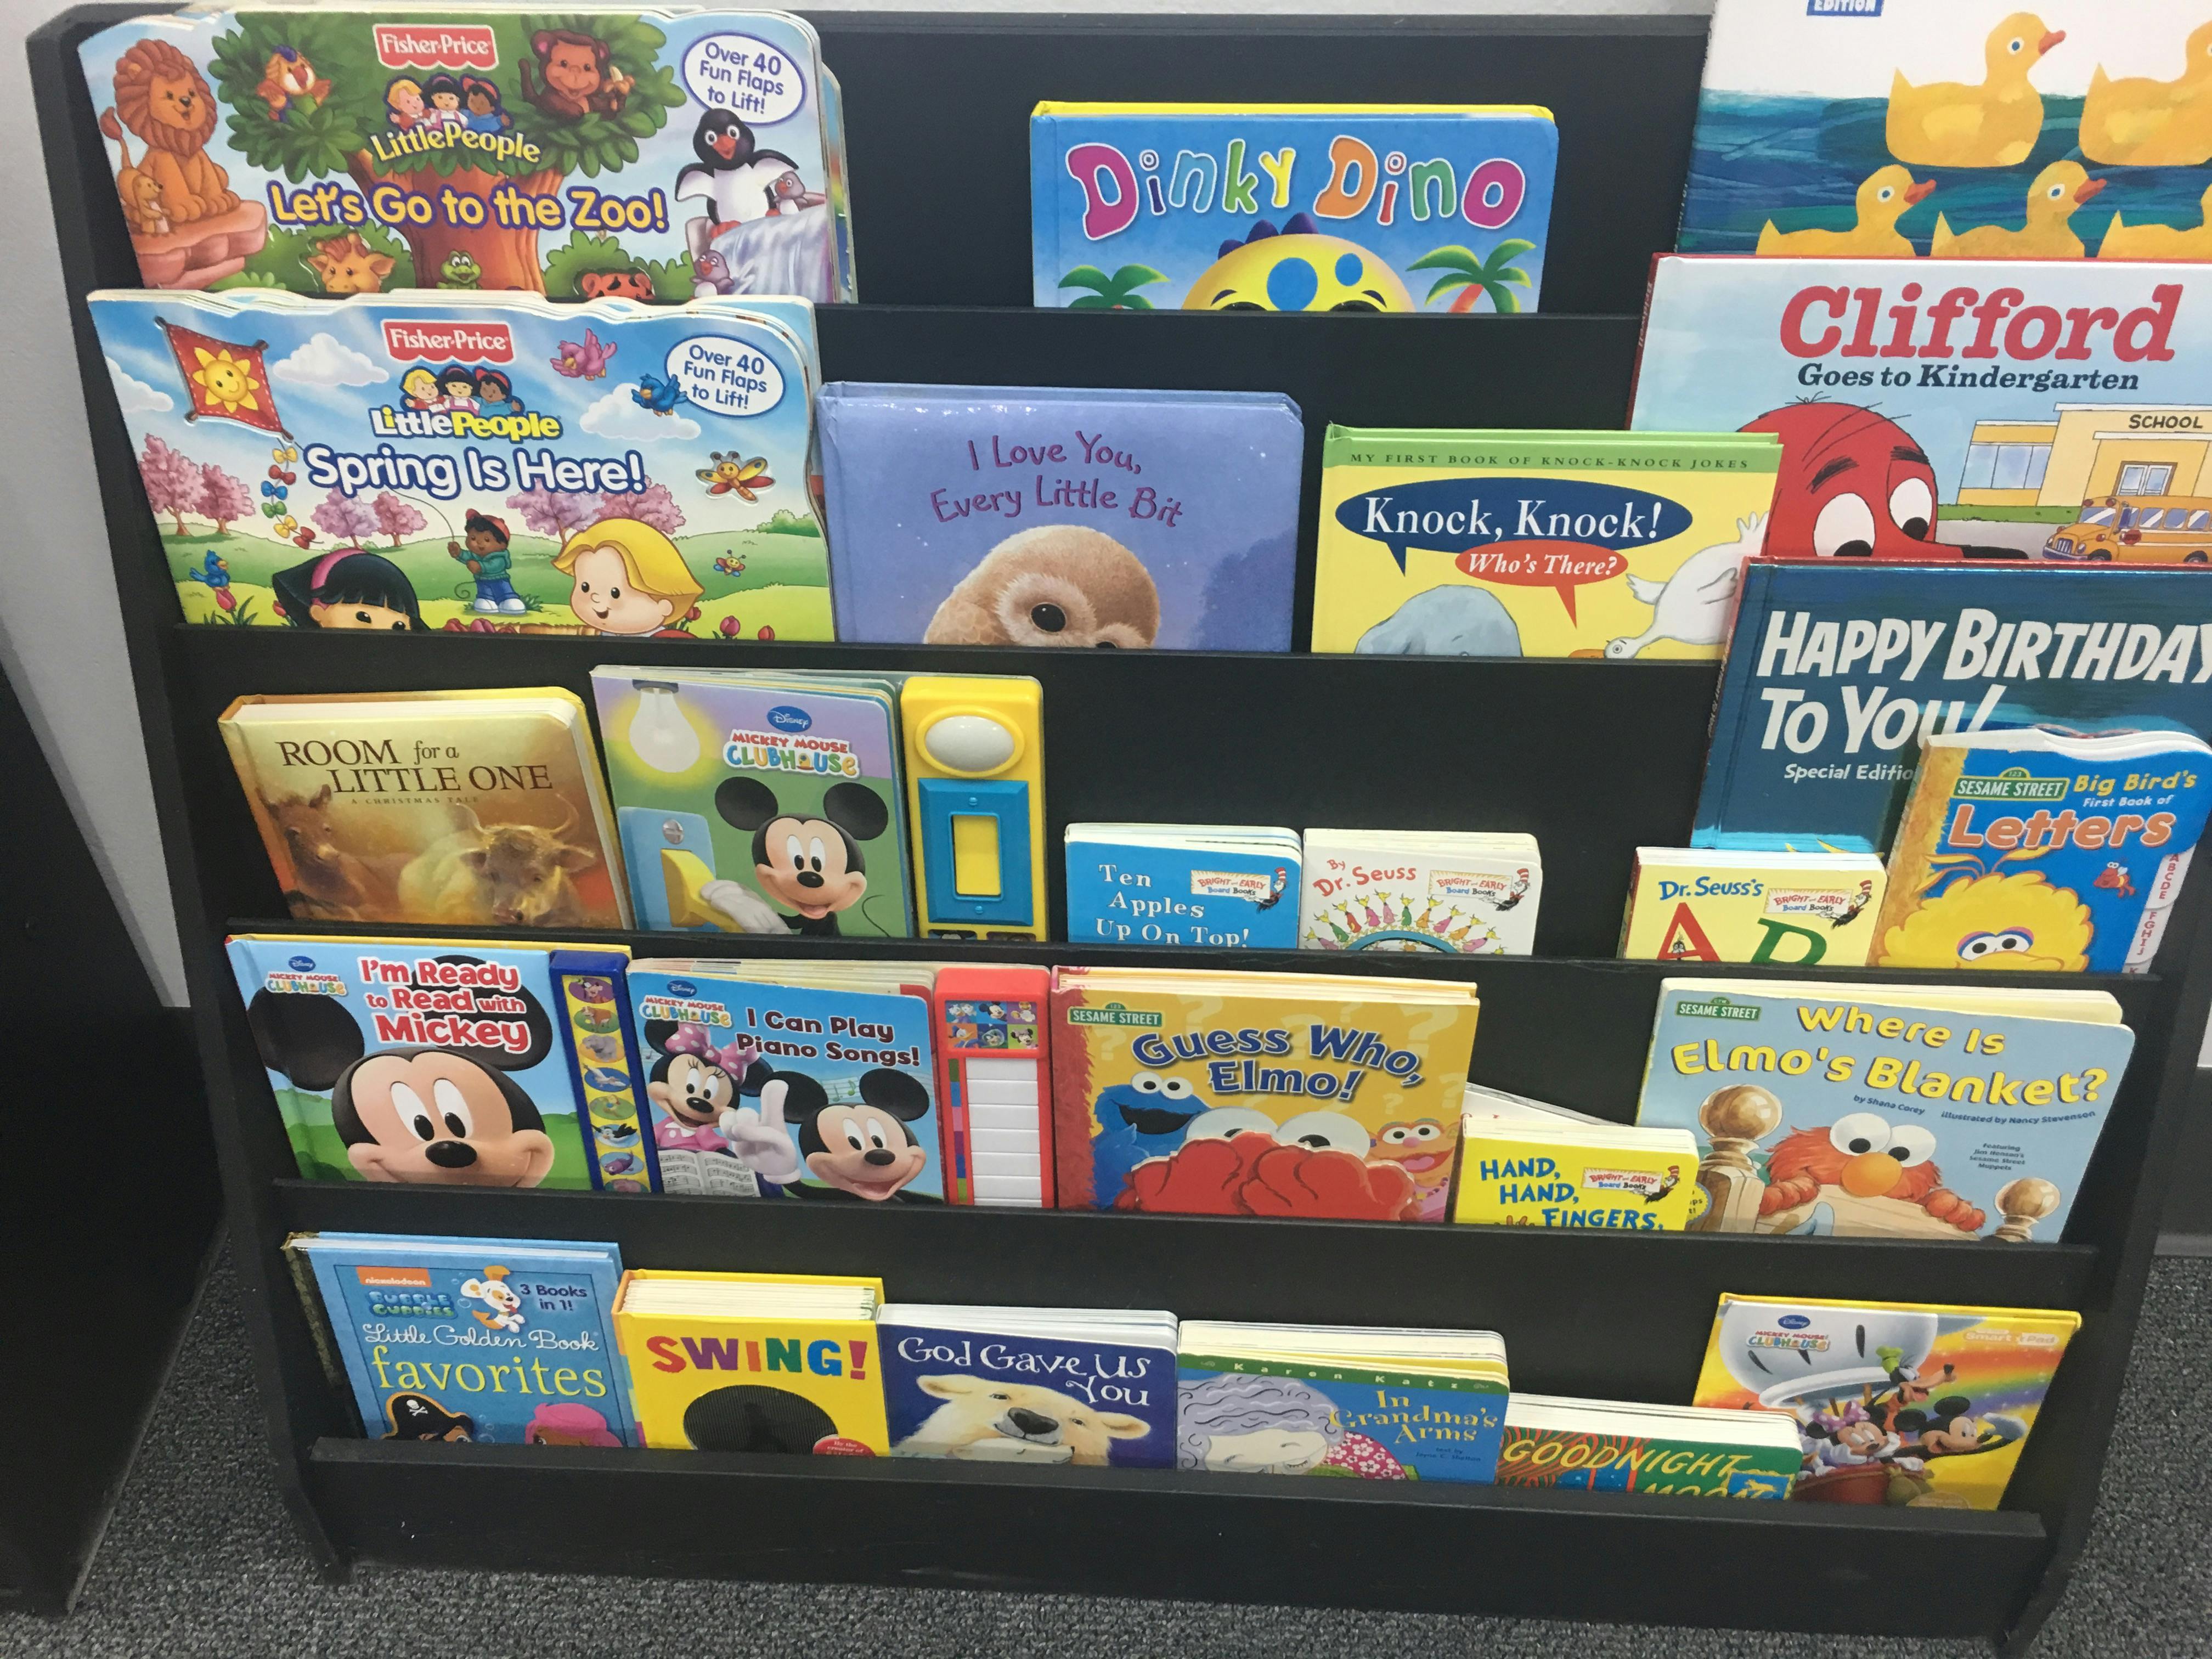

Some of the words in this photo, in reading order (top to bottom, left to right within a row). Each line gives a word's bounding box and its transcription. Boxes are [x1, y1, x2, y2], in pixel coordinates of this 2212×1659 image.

[381, 33, 490, 54] Fisher-Price
[705, 42, 748, 67] Over
[753, 55, 782, 77] 40
[699, 61, 732, 83] Fun
[737, 71, 784, 97] Flaps
[708, 86, 725, 104] to
[732, 93, 765, 115] Lift!
[1065, 138, 1296, 240] Dinky
[1313, 135, 1526, 229] Dino
[270, 183, 364, 225] Let's
[373, 187, 431, 223] Go
[442, 190, 484, 224] to
[488, 189, 561, 226] the
[573, 189, 668, 232] Zoo!
[1779, 282, 2183, 363] Clifford
[388, 329, 507, 352] Fisher-Price
[688, 343, 734, 370] Over
[737, 353, 766, 375] 40
[684, 363, 718, 384] Fun
[720, 369, 768, 395] Flaps
[1797, 363, 1875, 387] Goes
[1880, 366, 1911, 387] to
[1917, 364, 2139, 392] Kindergarten
[691, 384, 710, 402] to
[714, 390, 751, 411] Lift!
[2129, 414, 2204, 430] SCHOOL
[968, 440, 980, 471] I
[992, 435, 1067, 468] Love
[1075, 431, 1142, 474] You,
[1351, 454, 1375, 463] MY
[1385, 454, 1438, 464] FIRST
[1448, 455, 1499, 465] BOOK
[1509, 456, 1532, 465] OF
[1542, 457, 1682, 468] KNOCK-KNOCK
[1691, 459, 1748, 470] JOKES
[307, 447, 455, 498] Spring
[469, 452, 506, 489] Is
[521, 450, 646, 493] Here!
[930, 487, 1022, 523] Every
[1036, 475, 1118, 510] Little
[1128, 487, 1184, 527] Bit
[1363, 497, 1503, 540] Knock,
[1513, 500, 1662, 539] Knock!
[1468, 554, 1537, 574] Who's
[1544, 554, 1618, 577] There?
[1756, 611, 1948, 681] HAPPY
[1943, 608, 2212, 684] BIRTHDAY
[1760, 687, 1829, 754] TO
[275, 739, 403, 766] ROOM
[414, 741, 442, 765] for
[445, 745, 460, 759] a
[732, 732, 789, 747] MICKEY
[794, 739, 848, 754] MOUSE
[326, 767, 462, 793] LITTLE
[469, 765, 553, 791] ONE
[1784, 764, 1850, 783] Special
[2073, 775, 2115, 797] Big
[2123, 770, 2197, 791] Bird's
[1957, 780, 2012, 795] SESAME
[2013, 782, 2063, 797] STREET
[2083, 797, 2115, 808] First
[2119, 796, 2152, 806] Book
[2157, 793, 2176, 805] of
[1948, 804, 2177, 850] Letters
[1098, 864, 1152, 887] Ten
[1327, 859, 1346, 871] By
[1197, 877, 1232, 887] BRIGHT
[1239, 879, 1266, 889] EARLY
[1233, 887, 1256, 895] Books
[1312, 877, 1351, 896] Dr.
[1352, 865, 1417, 885] Seuss
[1436, 877, 1471, 888] BRIGHT
[1479, 880, 1508, 891] EARLY
[1472, 888, 1496, 897] Books
[1658, 880, 1691, 901] Dr.
[1694, 876, 1764, 896] Seuss's
[1107, 891, 1205, 918] Apples
[1773, 895, 1810, 906] BRIGHT
[1817, 895, 1847, 905] EARLY
[1096, 918, 1131, 941] Up
[1142, 924, 1181, 945] On
[1190, 927, 1250, 947] Top!
[1656, 902, 1722, 962] A
[361, 959, 414, 984] I'm
[417, 961, 520, 990] Ready
[366, 994, 387, 1009] to
[394, 988, 475, 1012] Read
[480, 998, 526, 1013] with
[646, 997, 684, 1007] MICKEY
[687, 1001, 724, 1012] MOUSE
[1679, 1003, 1719, 1016] SESAME
[1720, 1006, 1758, 1019] STREET
[746, 1008, 756, 1026] I
[765, 1011, 823, 1034] Can
[831, 1017, 895, 1043] Play
[1073, 1010, 1116, 1023] SESAME
[1119, 1013, 1159, 1025] STREET
[1797, 1006, 1950, 1049] Where
[1965, 1028, 2006, 1056] Is
[375, 1013, 530, 1053] Mickey
[736, 1032, 818, 1058] Piano
[826, 1042, 921, 1067] Songs!
[1131, 1029, 1289, 1066] Guess
[1310, 1024, 1426, 1087] Who,
[1207, 1059, 1364, 1102] Elmo!
[1672, 1039, 1857, 1083] Elmo's
[1864, 1056, 2109, 1107] Blanket?
[1853, 1094, 1866, 1103] by
[1867, 1097, 1896, 1109] Shana
[1897, 1103, 1926, 1115] Corey
[1941, 1110, 1993, 1123] illustrated
[1994, 1116, 2007, 1125] by
[2009, 1116, 2040, 1125] Nancy
[2041, 1110, 2096, 1124] Stevenson
[1480, 1157, 1561, 1181] HAND,
[1589, 1173, 1624, 1182] BRIGHT
[1630, 1175, 1658, 1184] EARLY
[1499, 1183, 1580, 1205] HAND,
[1542, 1207, 1664, 1230] FINGERS,
[365, 1277, 426, 1285] nickelodeon
[520, 1284, 531, 1295] 3
[537, 1284, 588, 1299] Books
[369, 1291, 450, 1306] BUBBLE
[539, 1299, 556, 1310] in
[560, 1299, 573, 1311] 1!
[363, 1323, 431, 1345] Little
[433, 1325, 527, 1348] Golden
[528, 1330, 600, 1352] Book
[1966, 1332, 2011, 1342] Smart
[646, 1335, 868, 1380] SWING!
[898, 1336, 972, 1367] God
[980, 1344, 1087, 1376] Gave
[371, 1345, 607, 1398] favorites
[1065, 1375, 1150, 1407] You
[1376, 1390, 1412, 1409] In
[1328, 1405, 1499, 1430] Grandma's
[1394, 1424, 1479, 1445] Arms
[1503, 1439, 1753, 1479] GOODNIGHT
